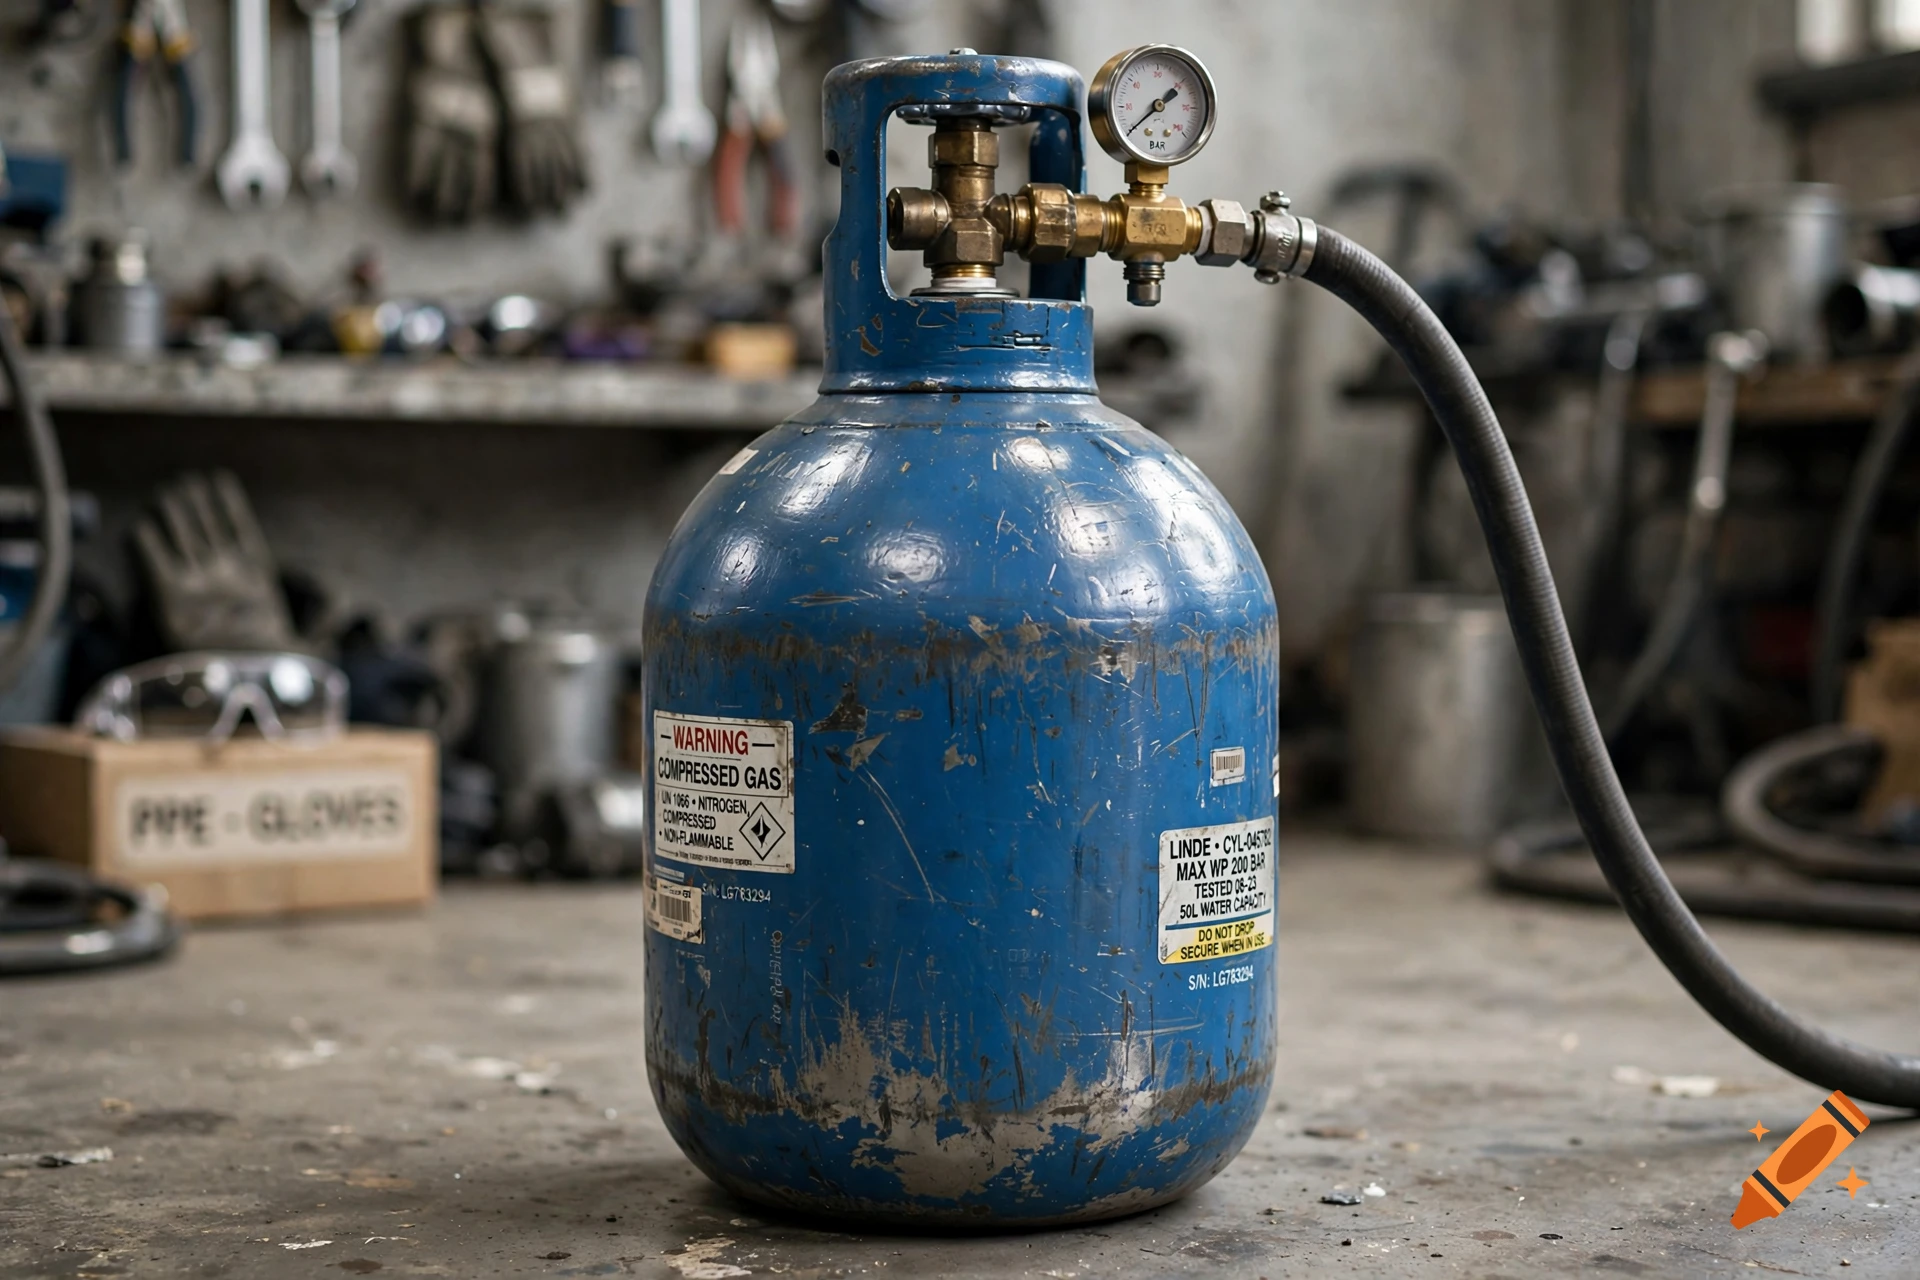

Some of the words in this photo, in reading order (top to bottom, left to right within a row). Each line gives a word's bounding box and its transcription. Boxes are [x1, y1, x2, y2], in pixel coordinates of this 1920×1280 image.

[1149, 140, 1166, 151] BAR
[673, 725, 748, 755] WARNING
[658, 757, 739, 787] COMPRESSED
[744, 766, 781, 790] GAS
[673, 792, 690, 809] 1066
[248, 785, 406, 845] GLOVES
[663, 808, 716, 830] COMPRESSED
[664, 827, 734, 851] NON-FLAMMABLE
[1170, 837, 1211, 859] LINDE
[1177, 860, 1206, 881] MAX
[1210, 858, 1228, 878] WP
[1231, 855, 1248, 875] 200
[1251, 851, 1266, 872] BAR
[1194, 879, 1233, 899] TESTED
[1180, 903, 1198, 919] 50L
[1200, 898, 1231, 917] WATER
[1198, 928, 1212, 942] DO
[1215, 924, 1233, 940] NOT
[1235, 921, 1255, 936] DROP
[1180, 942, 1219, 959] SECURE
[1221, 936, 1244, 954] WHEN
[1246, 935, 1253, 949] IN
[1188, 973, 1210, 991] S/N:
